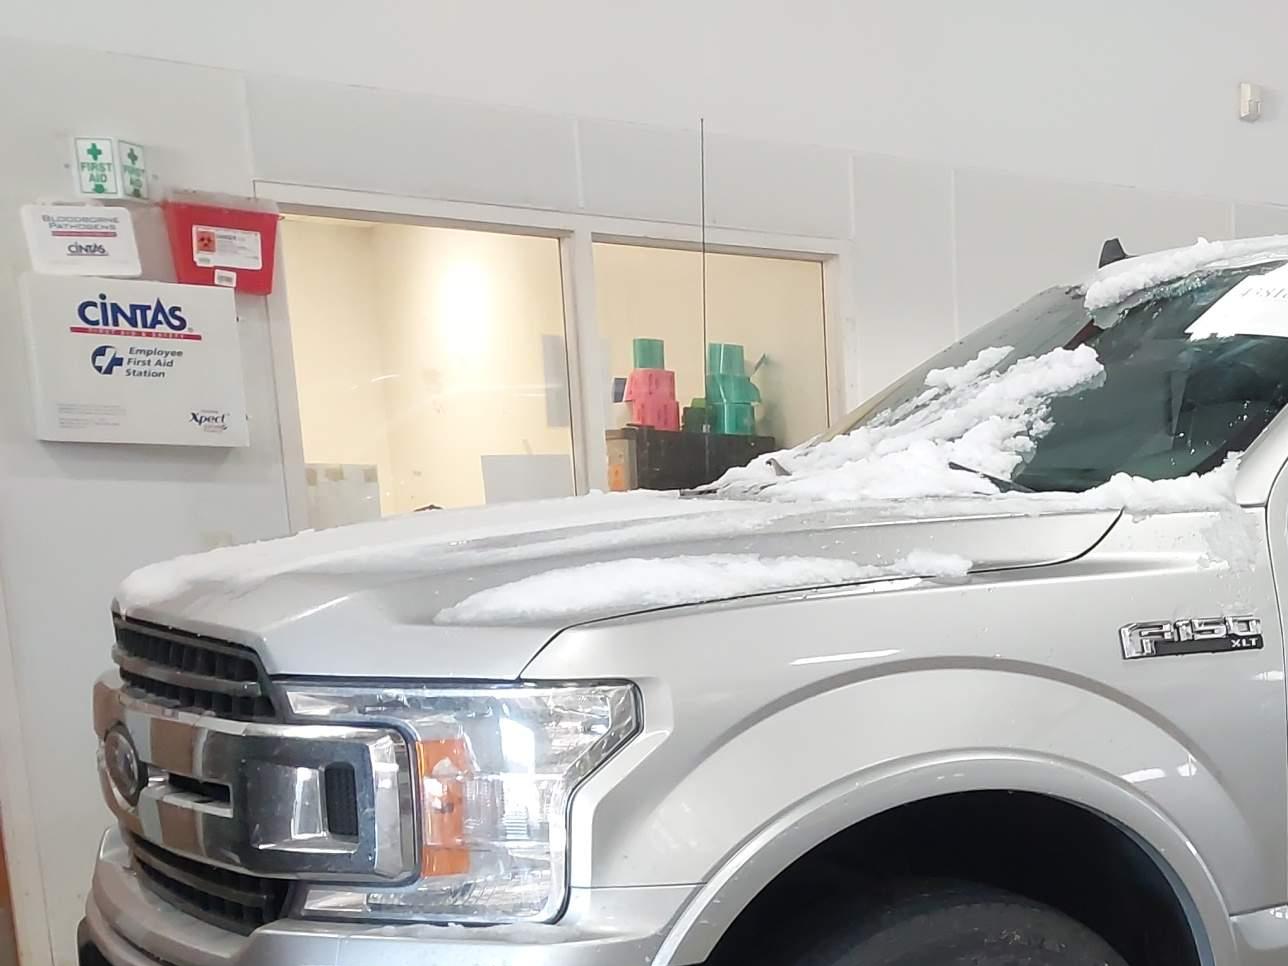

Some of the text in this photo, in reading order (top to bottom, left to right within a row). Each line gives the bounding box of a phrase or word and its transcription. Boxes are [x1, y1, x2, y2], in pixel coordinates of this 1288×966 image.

[80, 162, 113, 173] FIRST
[88, 174, 108, 183] AID
[128, 346, 184, 358] Employee
[126, 358, 175, 368] First Aid
[124, 368, 166, 378] Station
[1230, 637, 1259, 648] XLT
